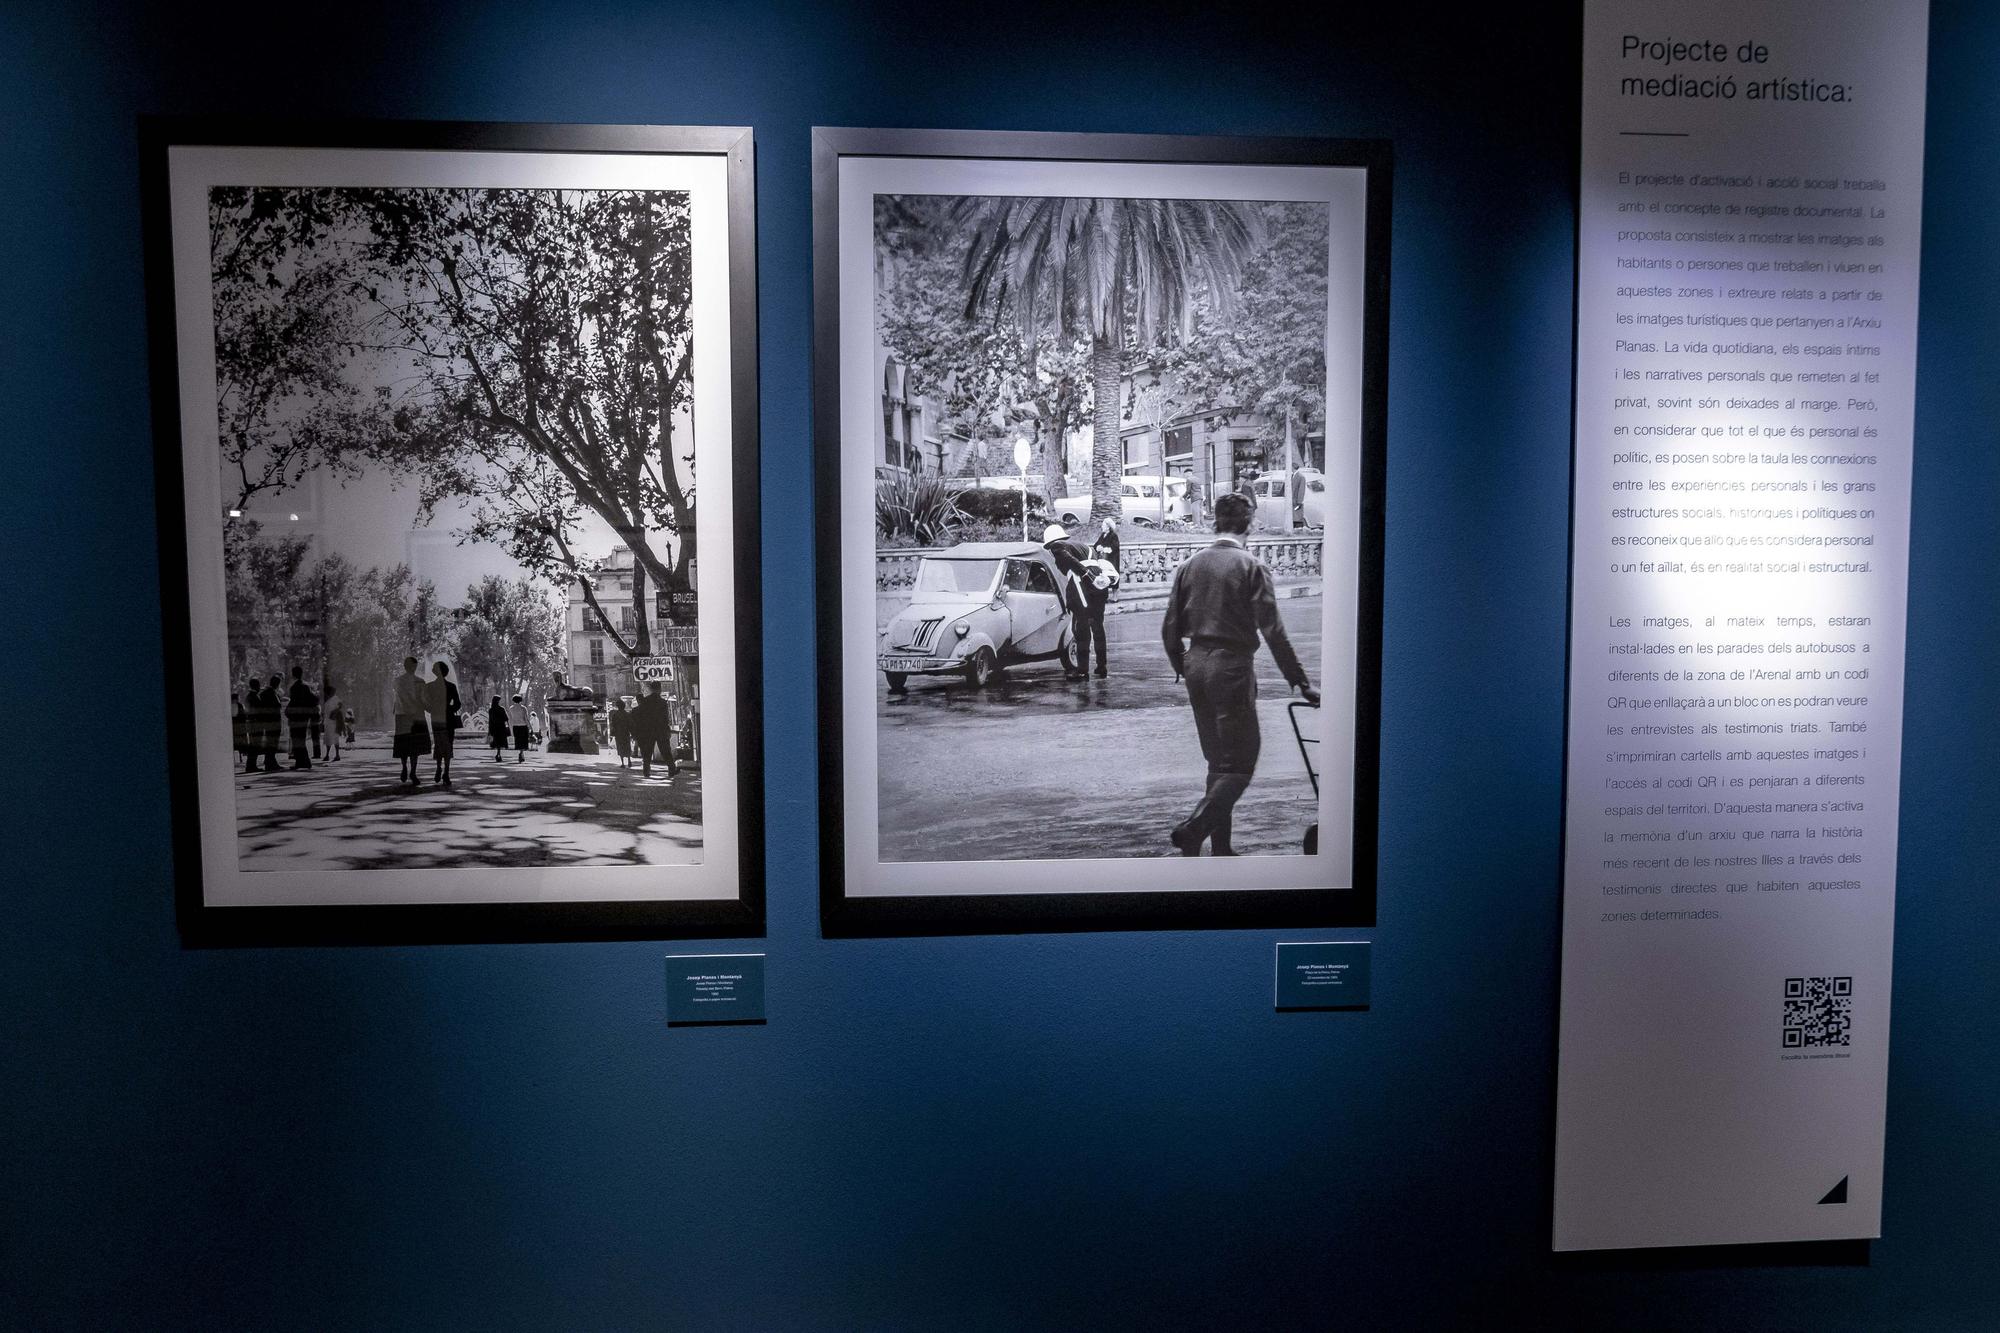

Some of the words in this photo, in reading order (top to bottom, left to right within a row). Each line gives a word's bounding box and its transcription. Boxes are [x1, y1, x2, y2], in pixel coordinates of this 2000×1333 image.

[1622, 35, 1728, 66] Projecte
[1737, 40, 1769, 64] de
[1621, 74, 1737, 100] mediació
[1746, 77, 1853, 103] artística:
[1635, 173, 1683, 189] projecte
[1690, 174, 1753, 187] d'activació
[1767, 175, 1800, 188] acció
[1805, 176, 1838, 189] social
[1843, 177, 1886, 190] treballa
[1618, 200, 1645, 213] amb
[1664, 202, 1720, 217] concepte
[1745, 203, 1788, 219] registre
[1618, 230, 1671, 245] proposta
[1675, 231, 1735, 243] consisteix
[1749, 232, 1793, 244] mostrar
[1797, 232, 1813, 244] les
[1818, 233, 1862, 248] imatges
[1867, 233, 1884, 245] als
[1617, 257, 1672, 270] habitants
[1687, 260, 1743, 274] persones
[1748, 261, 1769, 274] que
[1774, 259, 1823, 272] treballen
[1834, 261, 1864, 272] viuen
[1617, 285, 1672, 300] aquestes
[1678, 288, 1713, 298] zones
[1728, 287, 1775, 298] extreure
[1781, 287, 1813, 299] relats
[1832, 288, 1862, 303] partir
[1616, 312, 1634, 324] les
[1636, 313, 1683, 328] imatges
[1687, 314, 1747, 329] turístiques
[1751, 317, 1773, 329] que
[1776, 315, 1833, 330] pertanyen
[1847, 316, 1881, 328] l'Arxiu
[1616, 340, 1659, 353] Planas.
[1683, 341, 1708, 354] vida
[1712, 342, 1777, 357] quotidiana,
[1782, 342, 1799, 355] els
[1804, 343, 1841, 358] espais
[1847, 344, 1880, 356] íntims
[1623, 368, 1640, 380] les
[1645, 369, 1702, 381] narratives
[1707, 369, 1765, 384] personals
[1770, 372, 1792, 385] que
[1797, 370, 1845, 382] remeten
[1864, 370, 1879, 382] fet
[1614, 397, 1650, 411] privat,
[1657, 397, 1692, 409] sovint
[1698, 397, 1720, 409] són
[1726, 397, 1779, 409] deixades
[1800, 400, 1840, 413] marge.
[1847, 398, 1878, 412] Però,
[1633, 424, 1696, 436] considerar
[1701, 426, 1723, 439] que
[1728, 425, 1743, 436] tot
[1764, 426, 1785, 439] que
[1809, 424, 1859, 439] personal
[1613, 451, 1652, 466] polític,
[1672, 454, 1709, 466] posen
[1712, 451, 1745, 463] sobre
[1761, 451, 1789, 463] taula
[1791, 452, 1808, 464] les
[1810, 452, 1877, 464] connexions
[1612, 479, 1642, 490] entre
[1649, 478, 1665, 490] les
[1822, 479, 1838, 491] les
[1844, 482, 1875, 494] grans
[1612, 506, 1679, 518] estructures
[1801, 506, 1856, 521] polítiques
[1627, 534, 1677, 545] reconeix
[1679, 536, 1702, 548] que
[1824, 532, 1874, 548] personal
[1639, 560, 1654, 572] fet
[1657, 560, 1687, 574] aïllat,
[1809, 560, 1872, 572] estructural.
[1609, 615, 1631, 628] Les
[1643, 616, 1692, 630] imatges,
[1727, 615, 1765, 627] mateix
[1776, 615, 1816, 629] temps,
[1827, 614, 1871, 626] estaran
[1608, 642, 1675, 654] instal·lades
[1696, 642, 1713, 654] les
[1717, 641, 1764, 657] parades
[1768, 641, 1792, 653] dels
[1795, 641, 1856, 653] autobusos
[634, 666, 673, 681] GOYA
[1608, 669, 1659, 681] diferents
[1697, 671, 1725, 681] zona
[1749, 668, 1791, 680] l'Arenal
[1796, 668, 1820, 680] amb
[1844, 667, 1869, 679] codi
[1629, 698, 1652, 711] que
[1653, 695, 1704, 710] enllaçarà
[1733, 695, 1758, 707] bloc
[1794, 694, 1834, 709] podran
[1836, 696, 1868, 706] veure
[1607, 723, 1624, 735] les
[1631, 723, 1694, 735] entrevistes
[1701, 722, 1718, 734] als
[1725, 722, 1783, 734] testimonis
[1790, 721, 1821, 733] triats.
[1829, 720, 1867, 733] També
[1606, 749, 1676, 764] s'imprimiran
[1680, 748, 1722, 761] cartells
[1726, 748, 1752, 760] amb
[1756, 748, 1809, 763] aquestes
[1814, 747, 1859, 762] imatges
[1605, 776, 1647, 789] l'accés
[1667, 776, 1692, 788] codi
[1749, 775, 1798, 790] penjaran
[1815, 774, 1865, 786] diferents
[1604, 804, 1643, 818] espais
[1646, 803, 1664, 815] del
[1667, 803, 1710, 815] territori.
[1714, 801, 1772, 817] D'aquesta
[1775, 803, 1818, 813] manera
[1821, 800, 1864, 812] s'activa
[1620, 829, 1670, 842] memòria
[1676, 829, 1702, 841] d'un
[1708, 829, 1736, 841] arxiu
[1743, 830, 1764, 843] que
[1770, 830, 1800, 840] narra
[1821, 826, 1862, 839] història
[1603, 856, 1628, 868] més
[1632, 856, 1669, 868] recent
[1693, 854, 1710, 867] les
[1714, 854, 1757, 866] nostres
[1761, 853, 1783, 865] Illes
[1799, 852, 1833, 865] través
[1837, 852, 1862, 864] dels
[1602, 882, 1661, 895] testimonis
[1670, 881, 1717, 893] directes
[1725, 882, 1747, 895] que
[1756, 879, 1799, 892] habiten
[1807, 878, 1860, 894] aquestes
[1600, 912, 1636, 922] zones
[1640, 908, 1722, 921] determinades.
